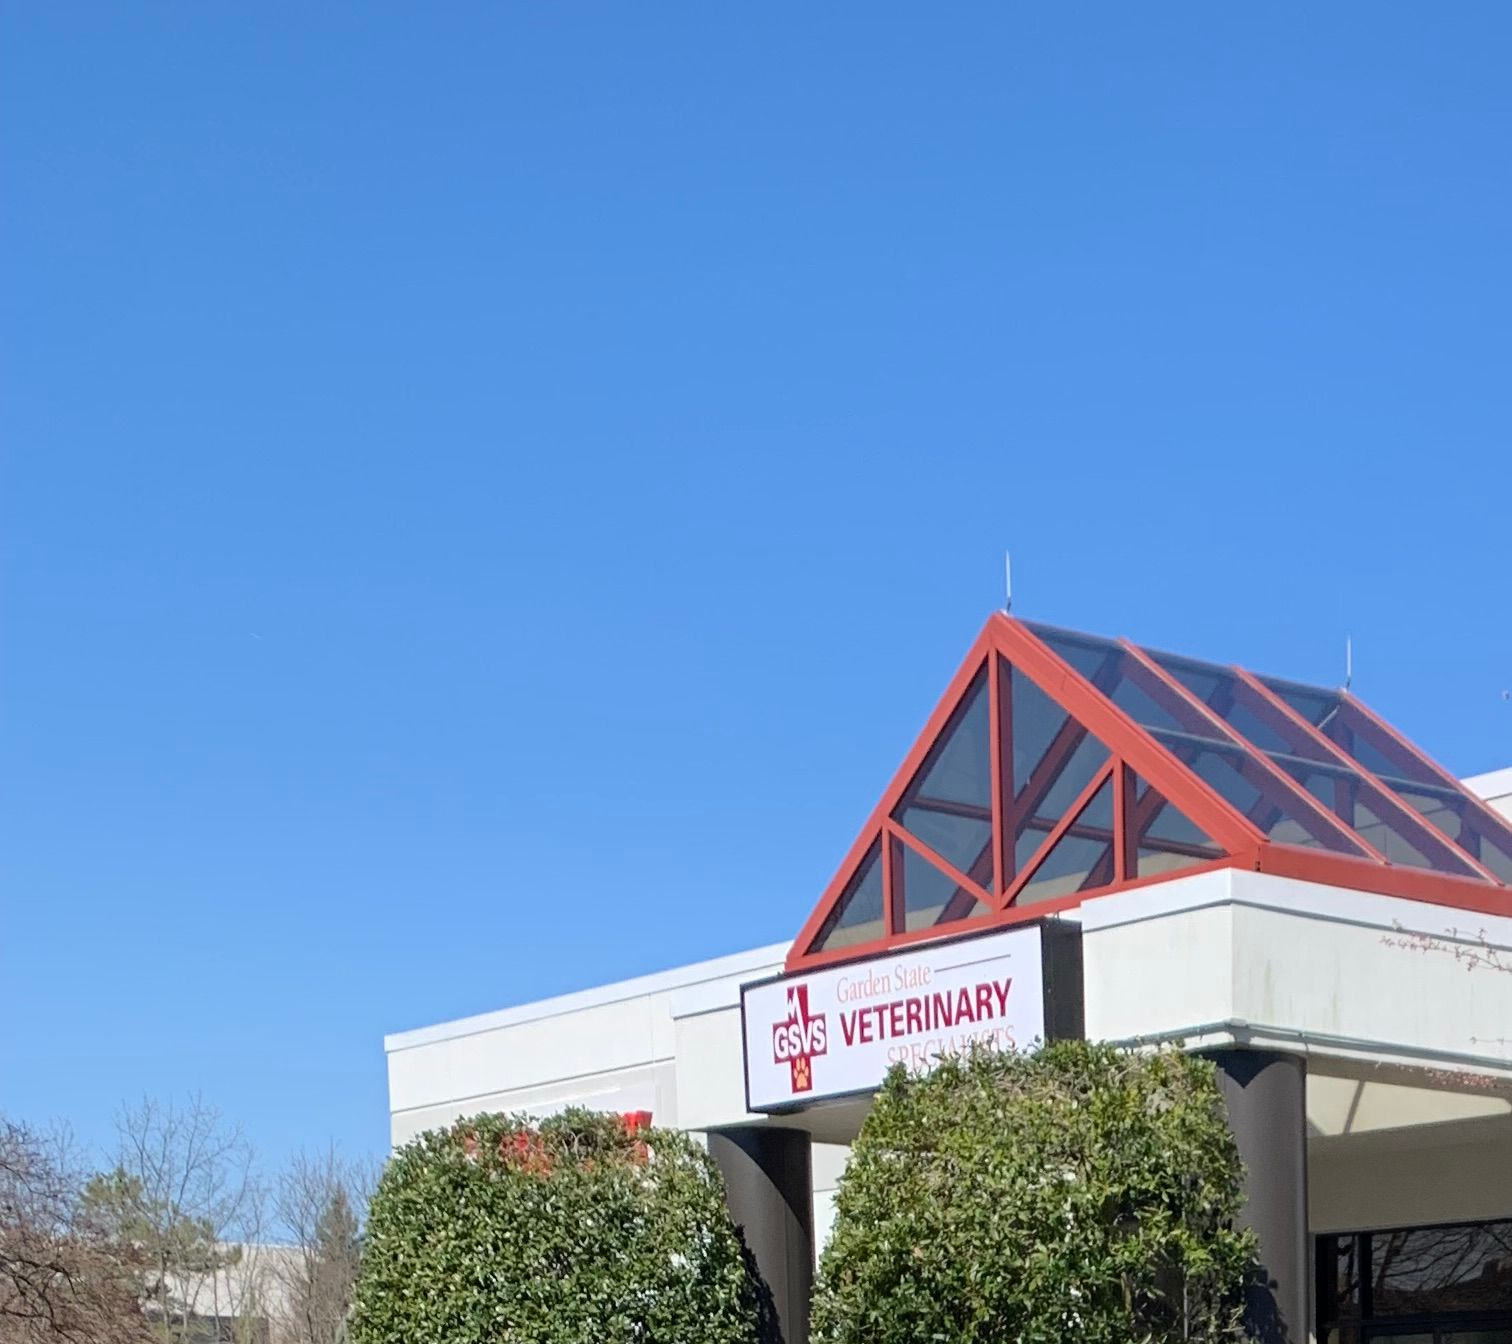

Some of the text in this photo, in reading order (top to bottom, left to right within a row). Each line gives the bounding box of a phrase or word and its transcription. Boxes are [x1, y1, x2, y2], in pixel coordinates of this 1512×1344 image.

[836, 964, 931, 1004] Garden State
[839, 978, 1013, 1046] VETERINARY
[773, 1018, 827, 1060] GSVS
